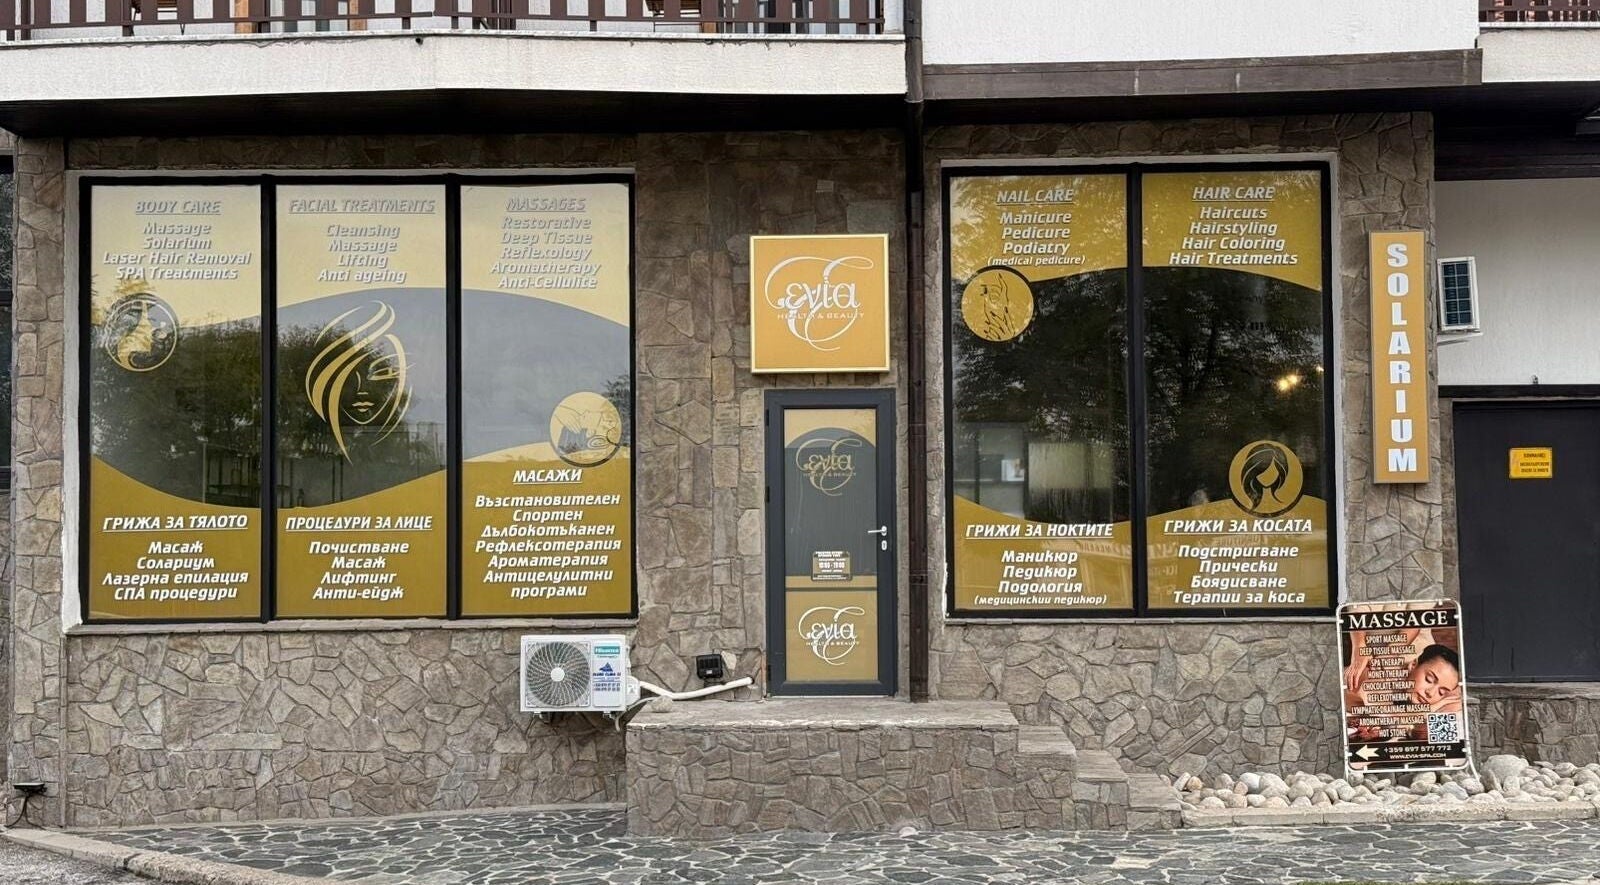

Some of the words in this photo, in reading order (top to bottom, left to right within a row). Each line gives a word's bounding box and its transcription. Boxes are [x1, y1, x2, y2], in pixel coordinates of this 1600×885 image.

[996, 190, 1031, 202] NAIL
[1035, 189, 1074, 201] CARE
[1193, 186, 1230, 199] HAIR
[1235, 186, 1275, 199] CARE
[136, 201, 177, 213] BODY
[183, 201, 222, 213] CARE
[289, 200, 338, 212] FACIAL
[342, 199, 436, 212] TREATMENTS
[506, 198, 587, 211] MASSAGES
[1000, 211, 1072, 224] Manicure
[1200, 207, 1268, 219] Haircuts
[143, 222, 212, 236] Massage
[501, 216, 592, 229] Restorative
[1190, 222, 1278, 236] Hairstyling
[327, 224, 400, 239] Cleansing
[1002, 226, 1071, 239] Pedicure
[143, 237, 212, 249] Solarium
[501, 232, 540, 246] Deep
[544, 232, 593, 244] Tissue
[1182, 237, 1216, 249] Hair
[1220, 237, 1285, 251] Coloring
[329, 240, 398, 254] Massage
[501, 247, 592, 261] Reflexology
[1003, 242, 1070, 255] Podiatry
[103, 252, 146, 265] Laser
[150, 252, 183, 265] Hair
[186, 252, 252, 265] Removal
[338, 255, 389, 269] Lifting
[987, 256, 1033, 266] (medical
[1035, 255, 1086, 266] pedicure)
[1169, 253, 1203, 265] Hair
[1208, 253, 1298, 265] Treatments
[116, 267, 145, 280] SPA
[149, 267, 239, 280] Treatments
[491, 262, 602, 276] Aromatherapy
[318, 270, 351, 282] Anti
[355, 270, 407, 284] ageing
[498, 276, 598, 289] Anti-Cellulite
[826, 312, 865, 320] BEAUTY
[1386, 243, 1417, 472] SOLARIUM
[512, 469, 583, 483] МАСАЖИ
[475, 494, 621, 508] Възстановителен
[103, 516, 160, 530] ГРИЖА
[165, 516, 184, 529] ЗА
[189, 515, 248, 529] ТЯЛОТО
[286, 516, 371, 530] ПРОЦЕДУРИ
[374, 516, 391, 529] ЗА
[394, 515, 432, 530] ЛИЦЕ
[513, 509, 583, 523] Спортен
[481, 524, 615, 538] Дълбокотъканен
[965, 524, 1020, 538] ГРИЖИ
[1024, 524, 1042, 537] ЗА
[1046, 523, 1114, 537] НОКТИТЕ
[1164, 519, 1224, 533] ГРИЖИ
[1228, 519, 1248, 532] ЗА
[1252, 519, 1312, 532] КОСАТА
[147, 541, 203, 554] Масаж
[309, 541, 409, 554] Почистване
[475, 540, 621, 554] Рефлексотерапия
[1178, 545, 1299, 559] Подстригване
[136, 556, 215, 571] Солариум
[331, 556, 386, 569] Масаж
[488, 555, 608, 570] Ароматерапия
[1001, 550, 1078, 564] Маникюр
[1003, 565, 1077, 579] Педикюр
[1199, 560, 1278, 574] Прически
[102, 573, 169, 587] Лазерна
[174, 572, 249, 585] епилация
[321, 572, 397, 585] Лифтинг
[483, 570, 613, 584] Антицелулитни
[1191, 576, 1287, 590] Боядисване
[114, 587, 145, 600] СПА
[150, 587, 238, 602] процедури
[312, 586, 404, 601] Анти-ейдж
[511, 586, 587, 599] програми
[998, 581, 1082, 595] Подология
[1054, 595, 1107, 606] педикюр)
[1173, 591, 1241, 605] Терапии
[1245, 592, 1264, 603] за
[1268, 591, 1305, 603] коса
[1348, 610, 1448, 629] MASSAGE
[1366, 635, 1382, 644] SPORT
[1383, 634, 1408, 643] MASSAGE
[1360, 647, 1372, 656] DEEP
[1373, 647, 1390, 655] TISSUE
[1391, 646, 1416, 654] MASSAGE
[1371, 658, 1381, 666] SPA
[1381, 657, 1405, 666] THERAPY
[1368, 670, 1385, 678] HONEY
[1386, 669, 1409, 678] THERAPY
[1363, 682, 1390, 691] CHOCOLATE
[1391, 681, 1416, 690] THERAPY
[1368, 693, 1412, 702] REFLEXOTHERAPY
[1406, 704, 1431, 712] MASSAGE
[1360, 717, 1400, 726] AROMATHERAPY
[1401, 716, 1425, 724] MASSAGE
[1379, 730, 1389, 738] HOT
[1390, 729, 1407, 737] STONE
